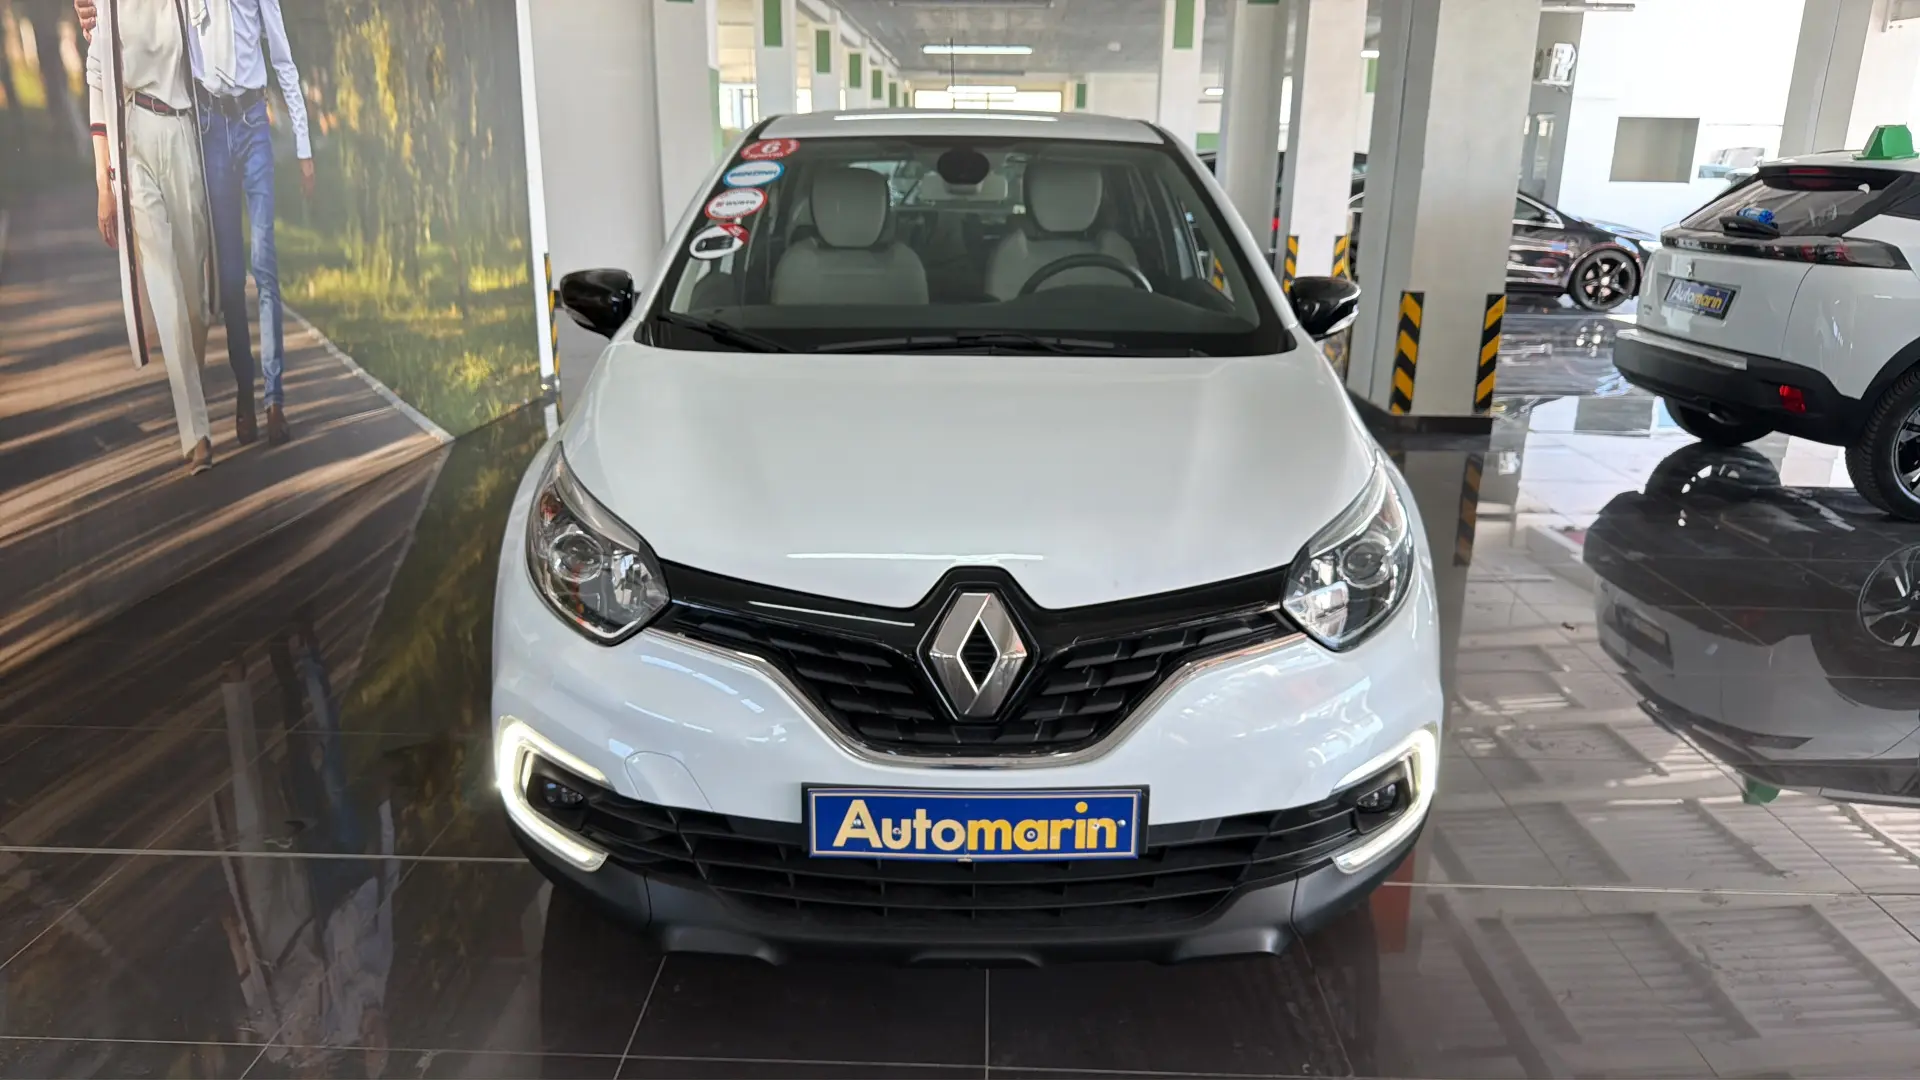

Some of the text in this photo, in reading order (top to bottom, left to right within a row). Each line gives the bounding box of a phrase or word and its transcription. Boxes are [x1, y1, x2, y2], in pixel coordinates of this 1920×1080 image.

[761, 140, 781, 154] 6
[1669, 282, 1722, 309] Automarin
[832, 799, 1117, 851] Automarin
